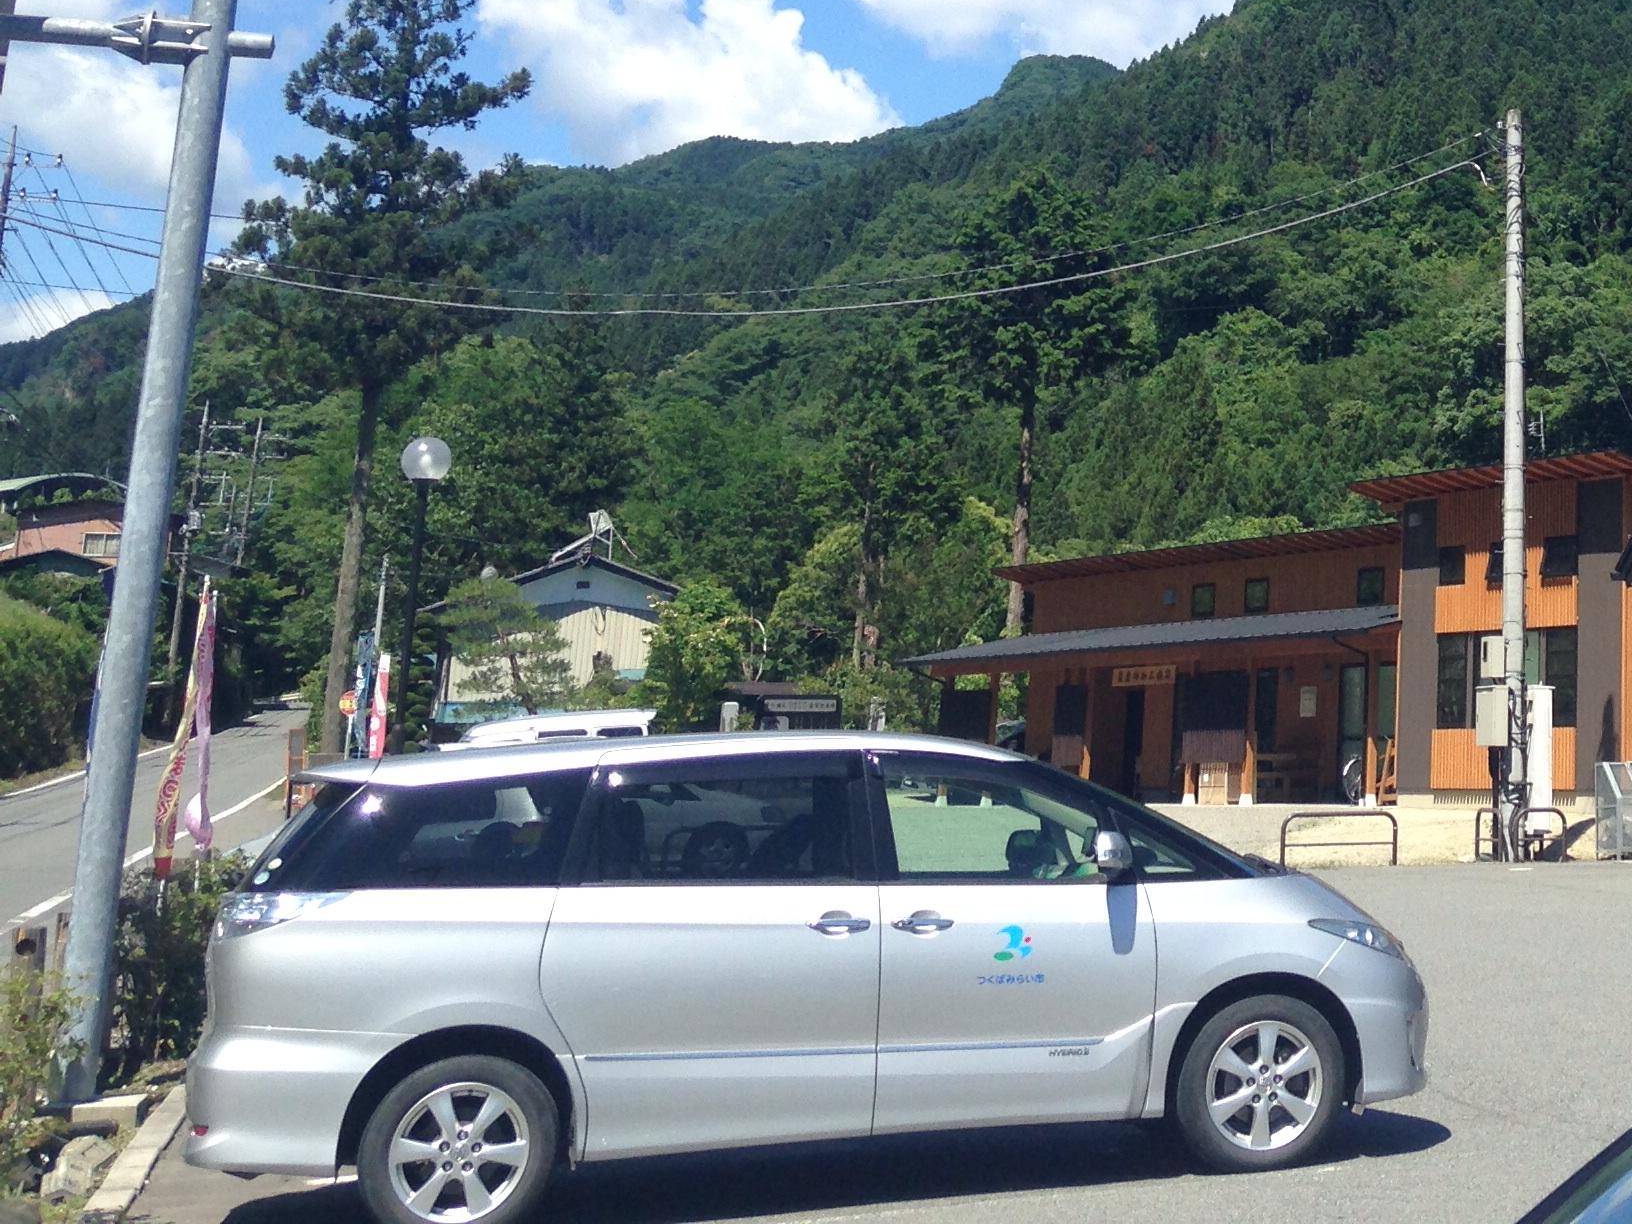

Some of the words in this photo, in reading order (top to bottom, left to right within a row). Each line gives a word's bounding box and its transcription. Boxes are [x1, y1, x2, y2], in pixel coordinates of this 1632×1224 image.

[976, 973, 1045, 985] つくばみらい市
